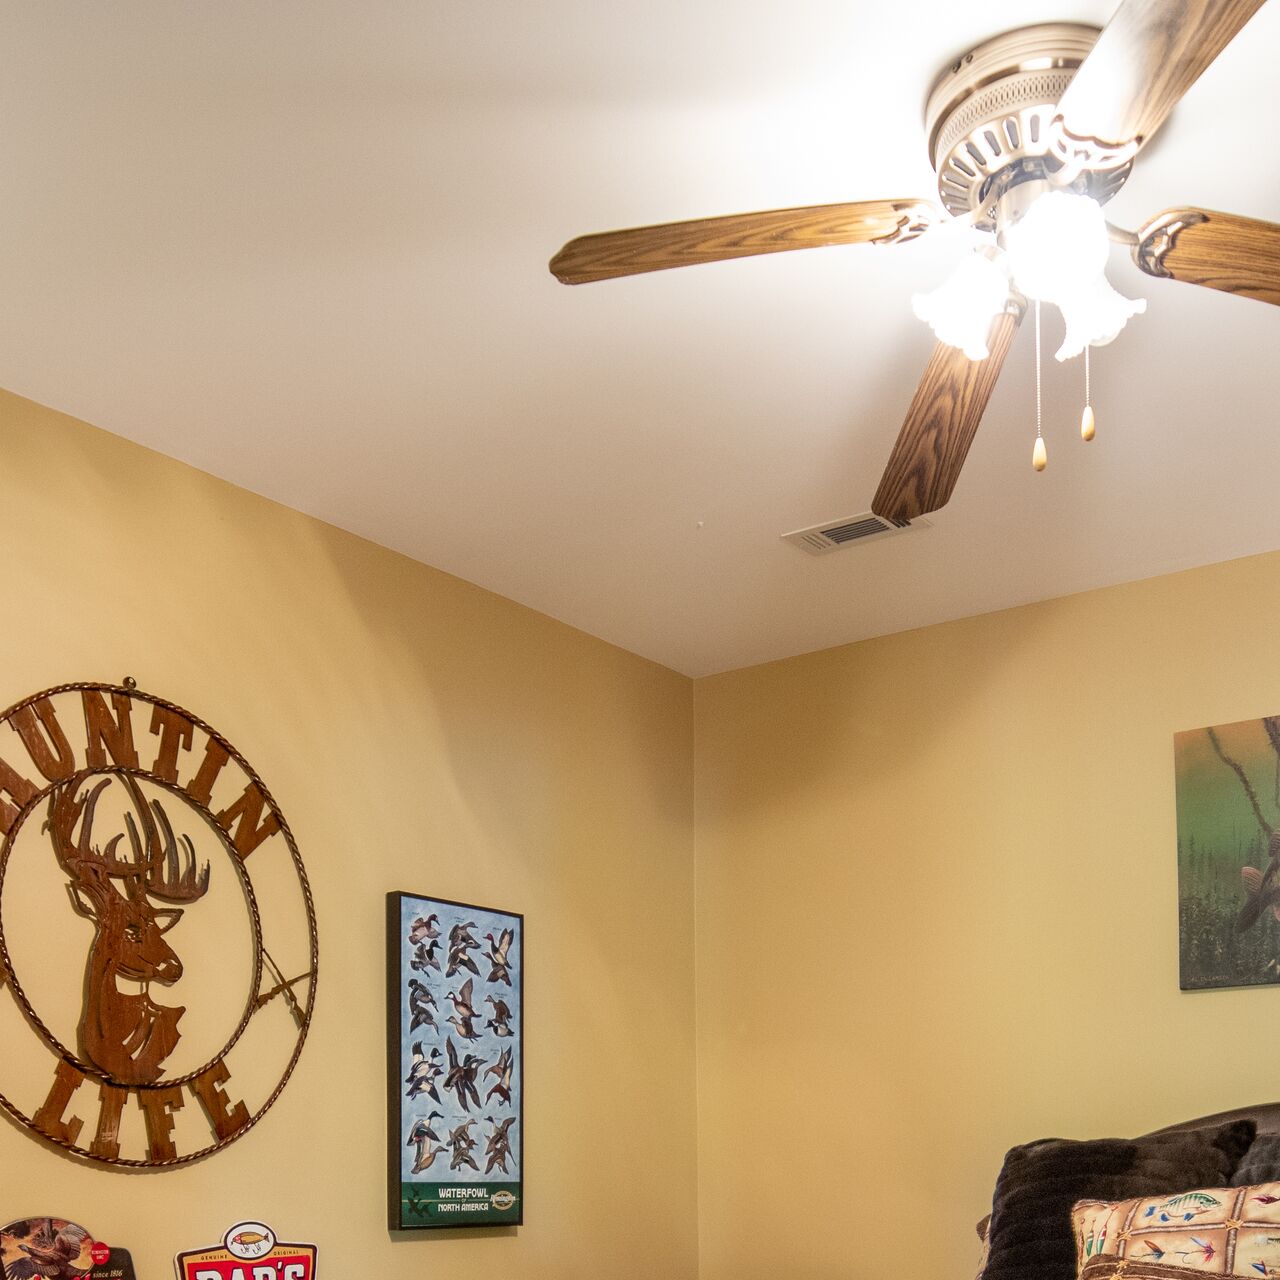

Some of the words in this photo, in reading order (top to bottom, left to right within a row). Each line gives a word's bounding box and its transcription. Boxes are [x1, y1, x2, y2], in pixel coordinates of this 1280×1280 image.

[31, 1058, 251, 1162] LIFE
[438, 1188, 489, 1198] WATERFOWL
[438, 1204, 460, 1212] NORTH
[461, 1203, 489, 1212] AMERICA
